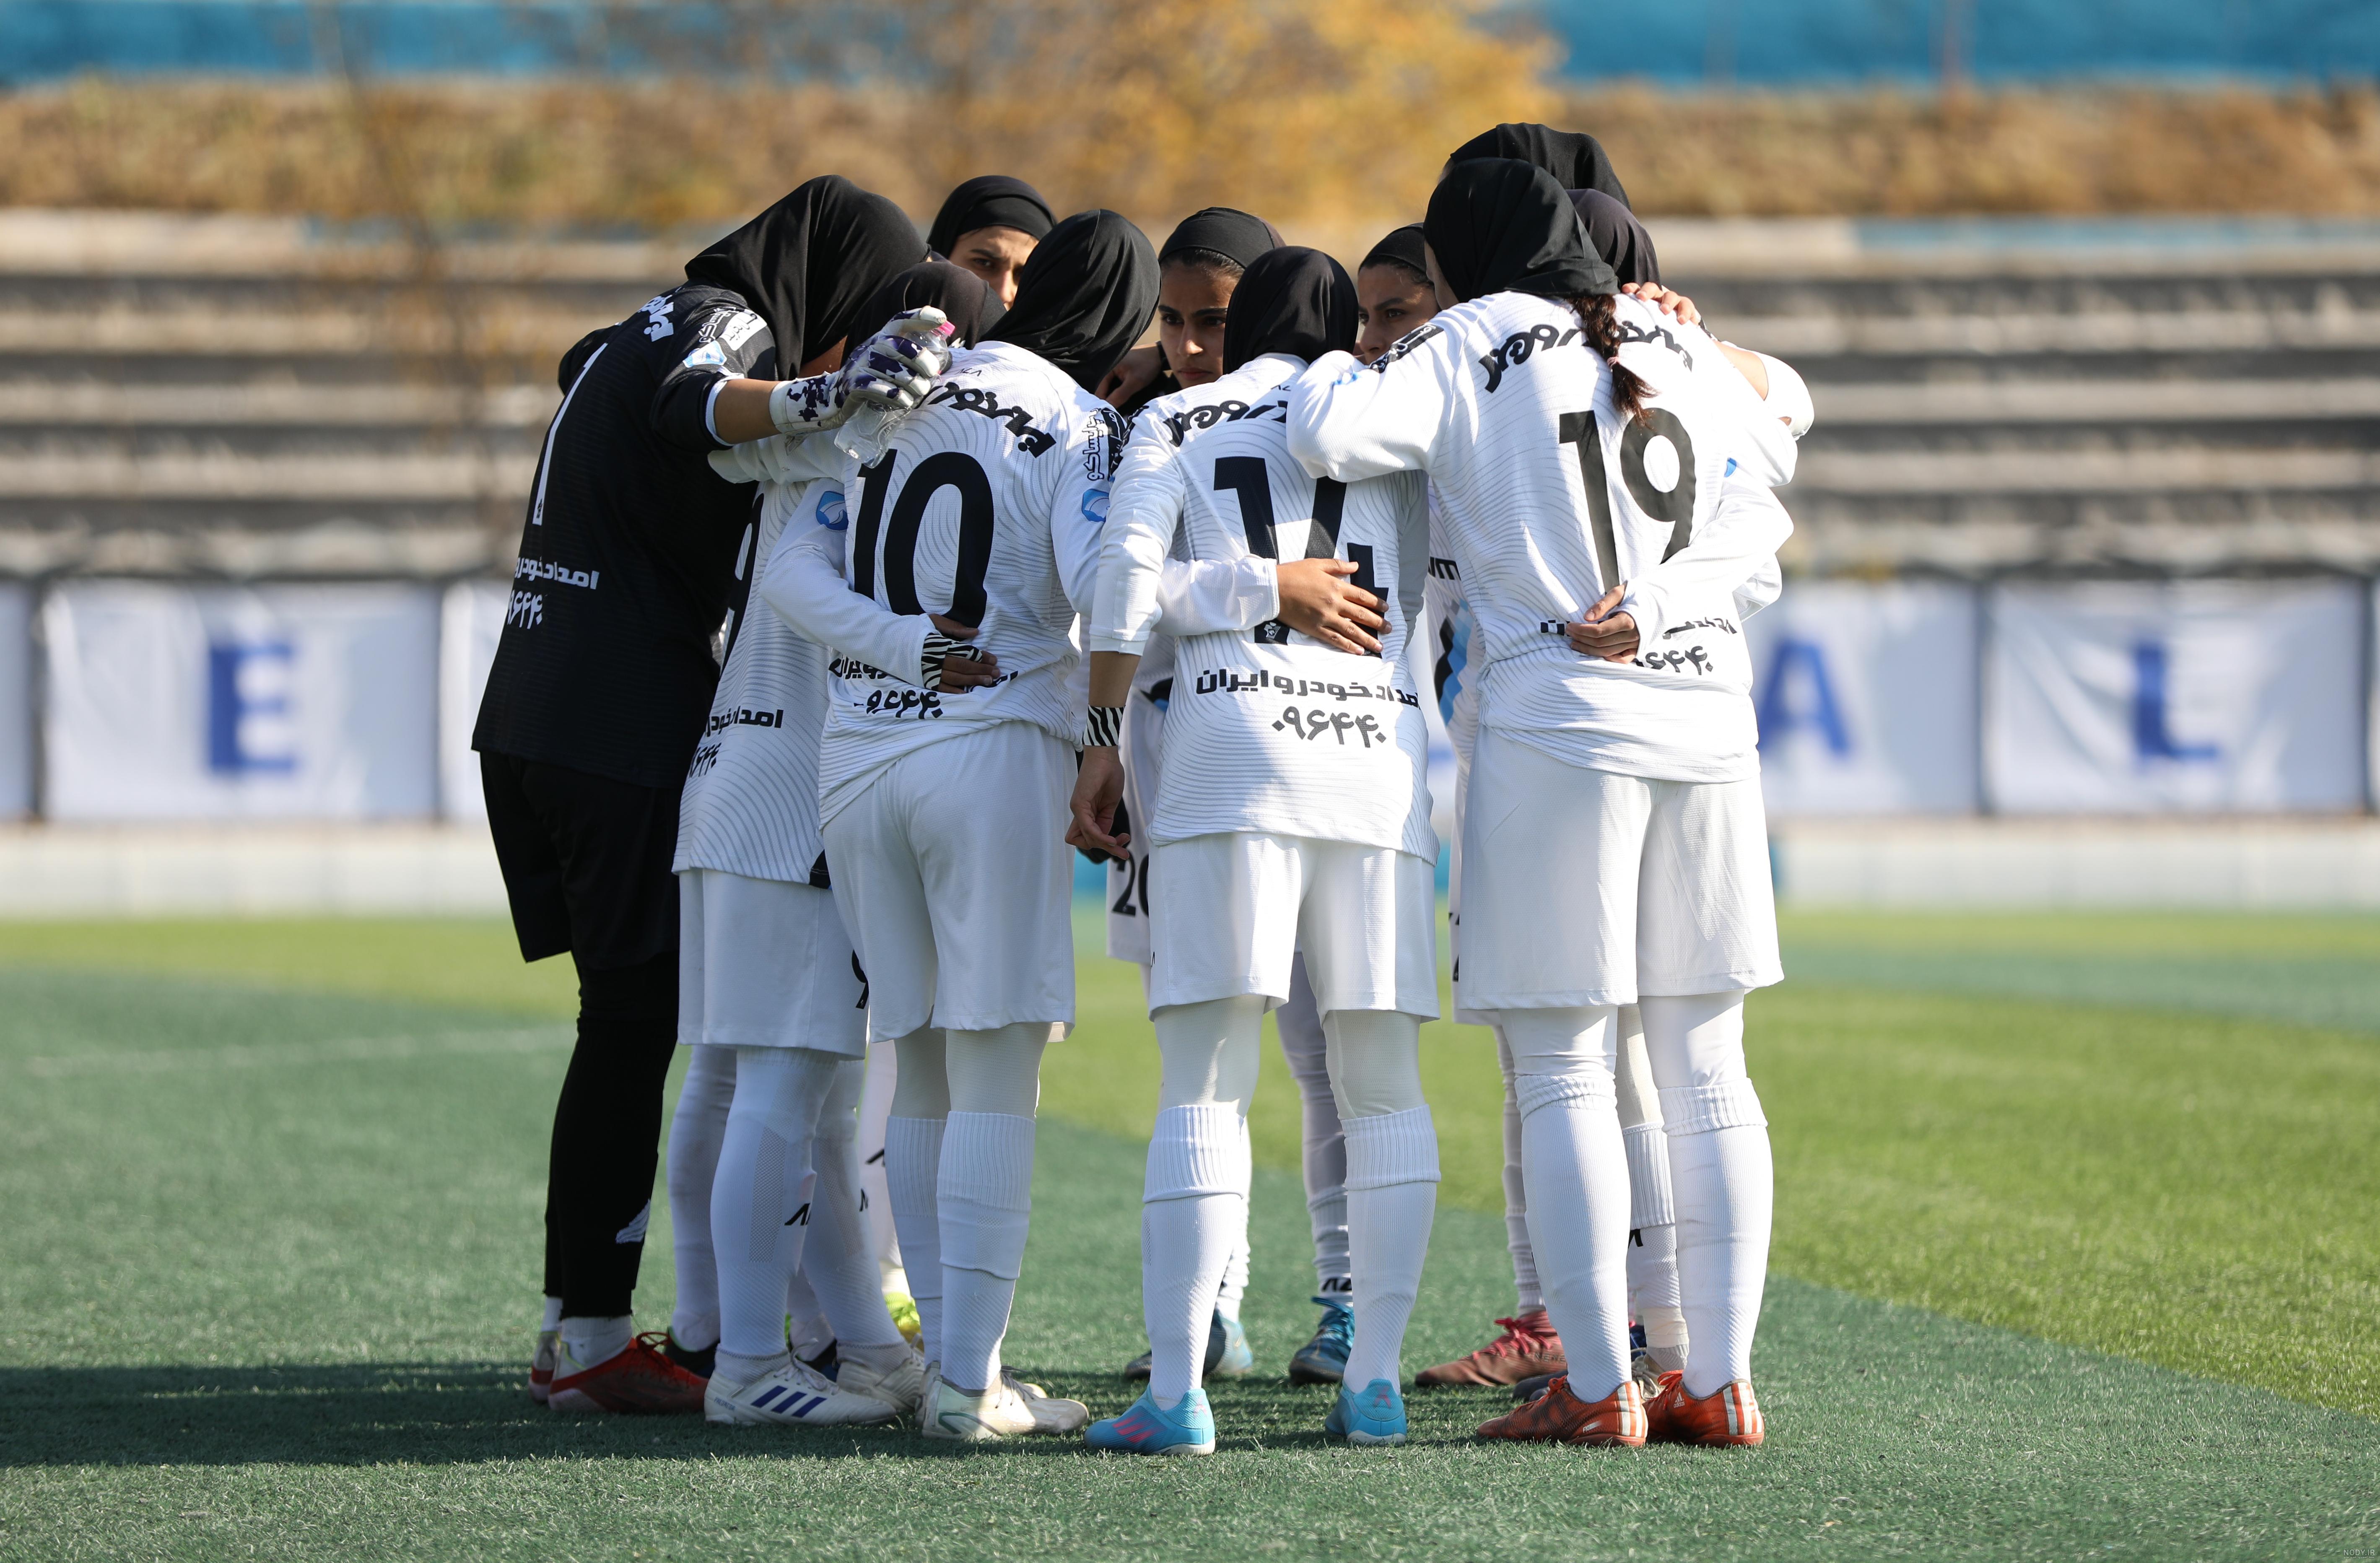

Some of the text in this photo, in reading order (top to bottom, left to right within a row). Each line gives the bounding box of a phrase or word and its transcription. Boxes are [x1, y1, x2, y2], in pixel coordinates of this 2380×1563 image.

[854, 449, 994, 632] 10
[1559, 407, 1697, 596] 19
[1196, 668, 1269, 694] ایران
[1273, 675, 1373, 701] خودرو
